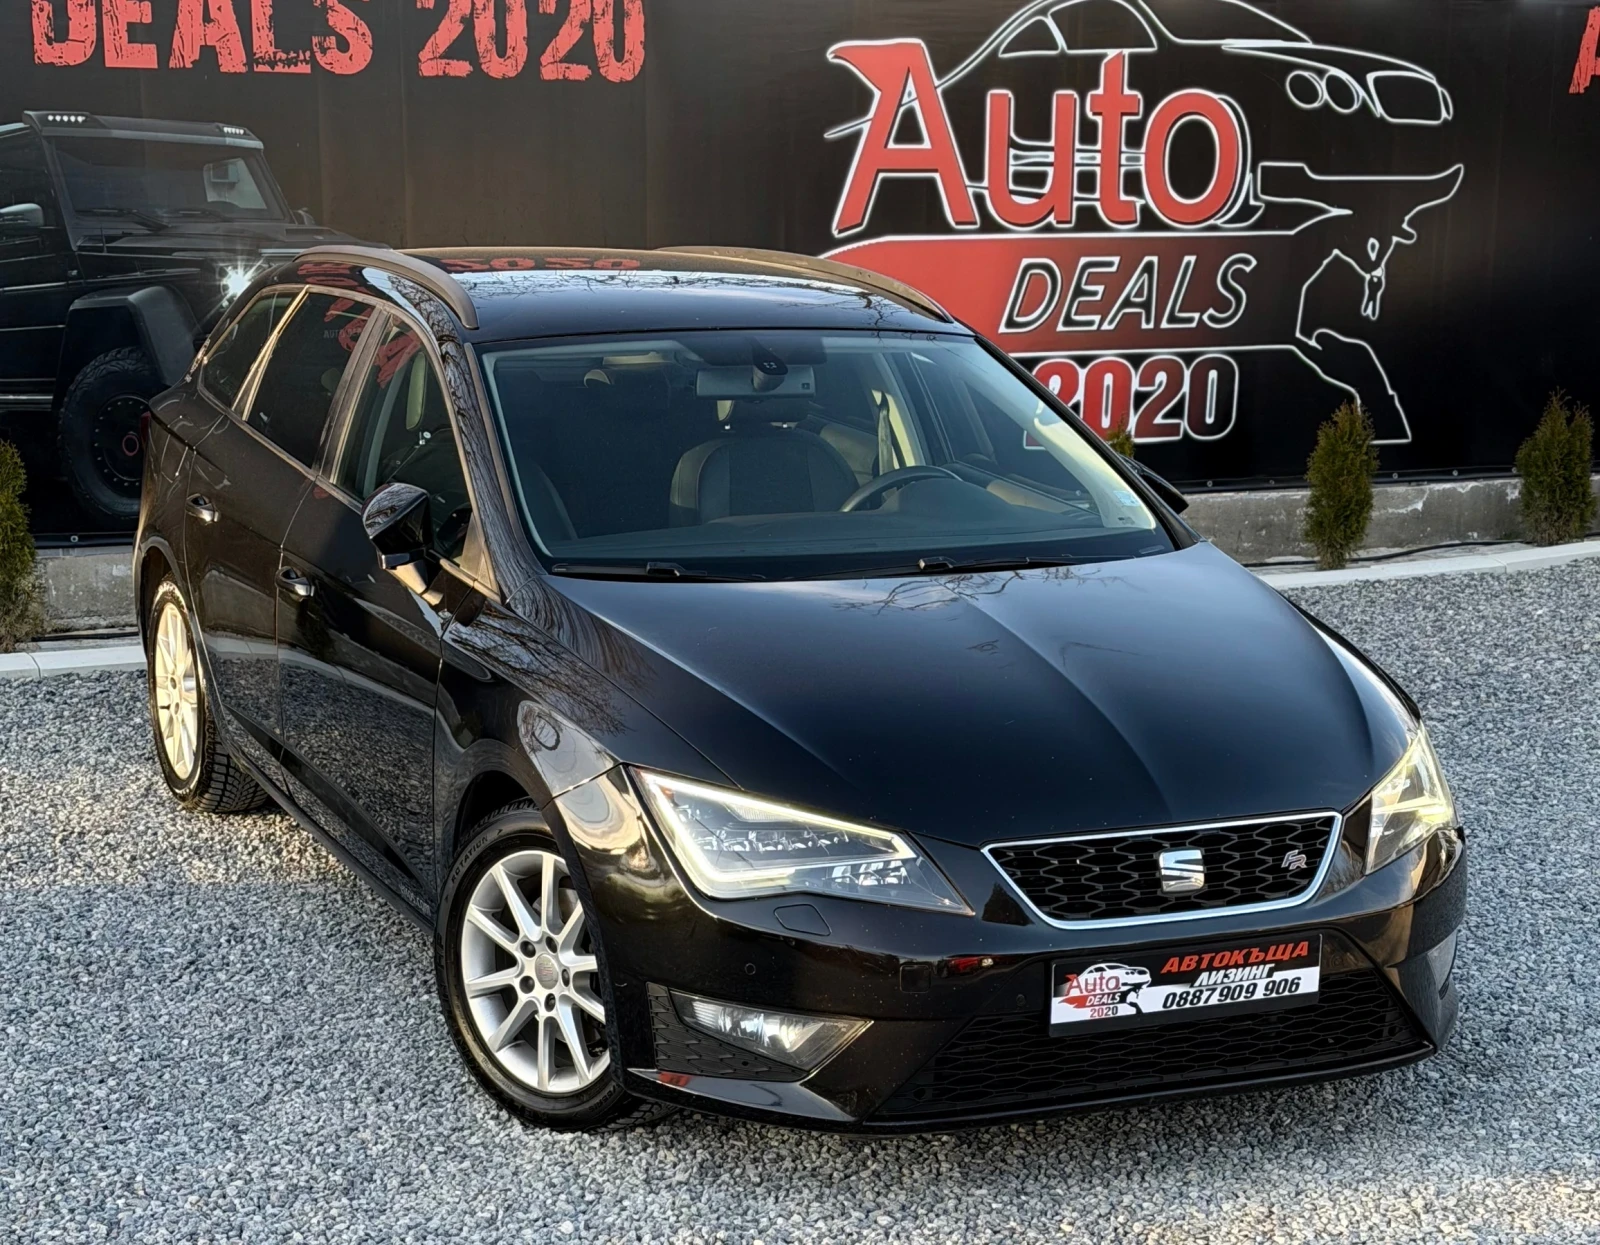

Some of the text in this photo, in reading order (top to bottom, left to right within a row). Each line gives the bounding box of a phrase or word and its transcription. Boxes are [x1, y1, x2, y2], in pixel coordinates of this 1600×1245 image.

[31, 0, 645, 82] DEALS 2020
[827, 38, 1243, 235] Auto
[998, 252, 1258, 333] DEALS
[451, 834, 489, 885] ROTATION
[1160, 941, 1310, 974] АВТОКЪЩА
[1065, 971, 1121, 996] Auto
[1192, 963, 1275, 988] ЛИЗИНГ
[1263, 976, 1302, 997] 906
[1085, 993, 1122, 1006] DEALS
[1090, 1005, 1118, 1018] 2020
